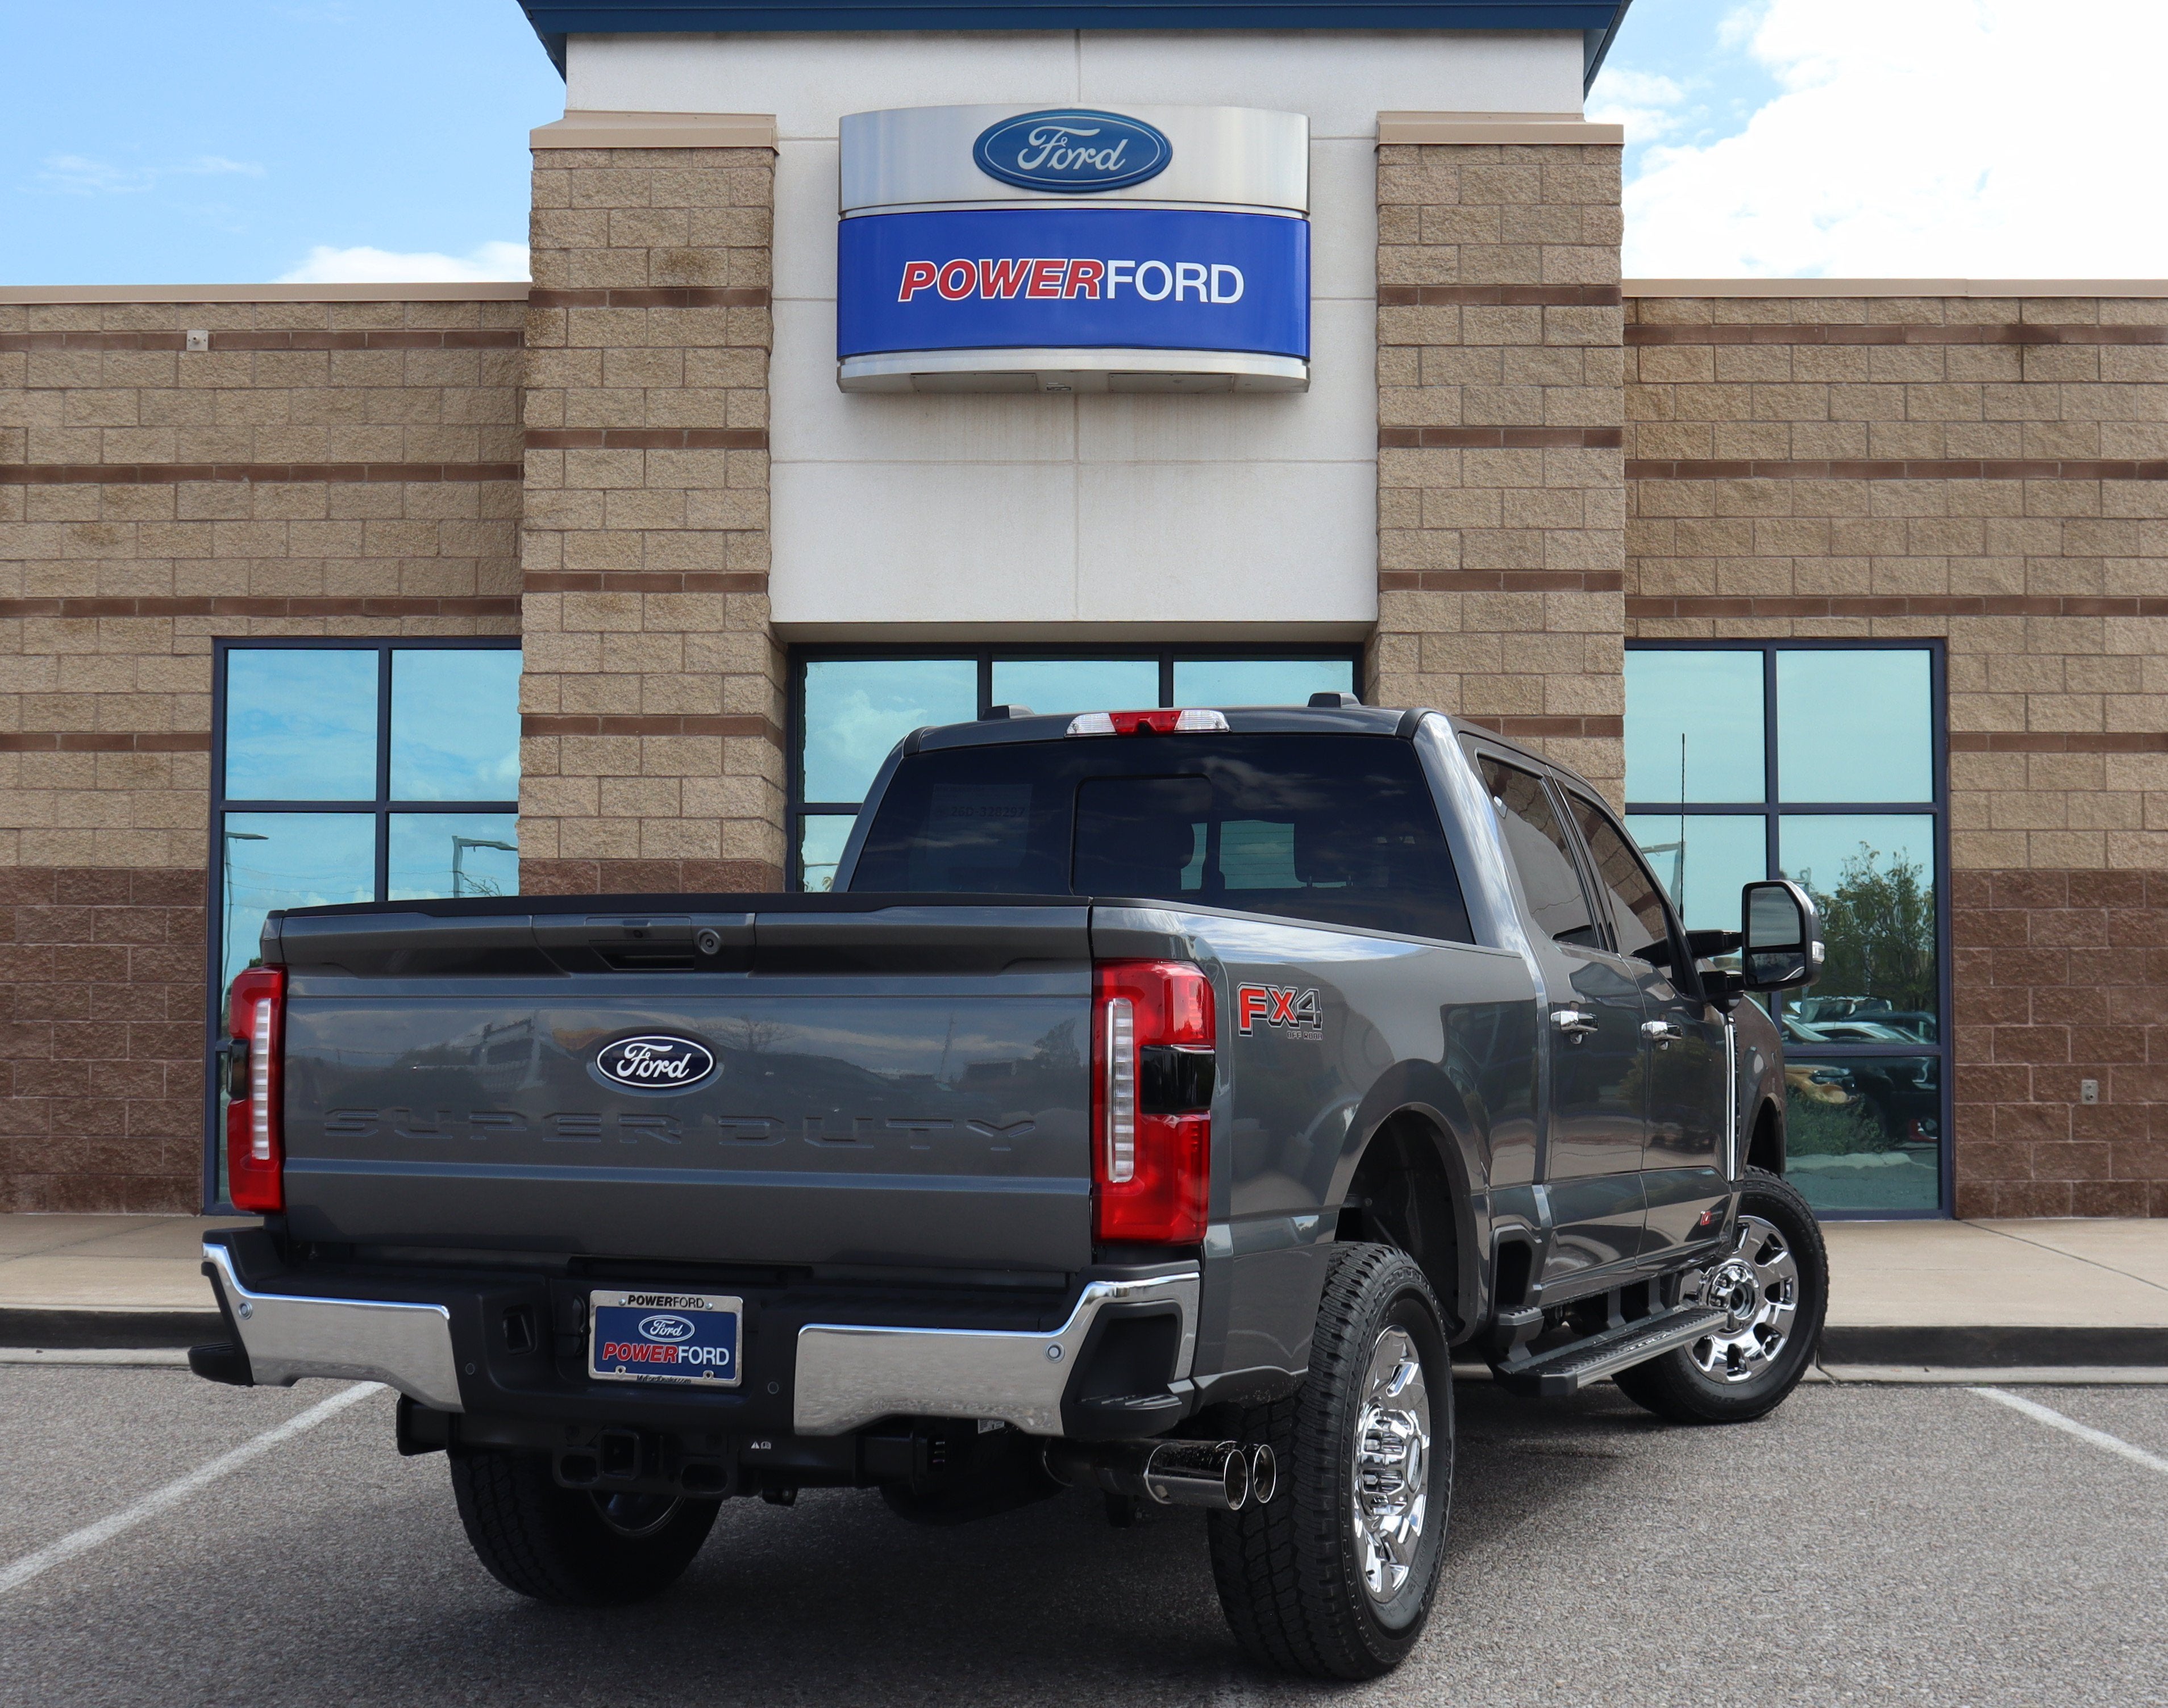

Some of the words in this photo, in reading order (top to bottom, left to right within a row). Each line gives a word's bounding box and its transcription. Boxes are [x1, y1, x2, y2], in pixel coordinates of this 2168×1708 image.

[1017, 125, 1129, 172] Ford
[898, 258, 1244, 304] POWERFORD
[1237, 982, 1322, 1037] FX4
[1287, 1030, 1301, 1039] OFF
[1303, 1031, 1323, 1040] ROAD
[617, 1043, 692, 1078] Ford
[324, 1108, 682, 1144] SUPER
[718, 1115, 1035, 1151] DUTY
[627, 1295, 704, 1309] POWERFORD
[650, 1319, 683, 1336] Ford
[602, 1342, 729, 1365] POWERFORD
